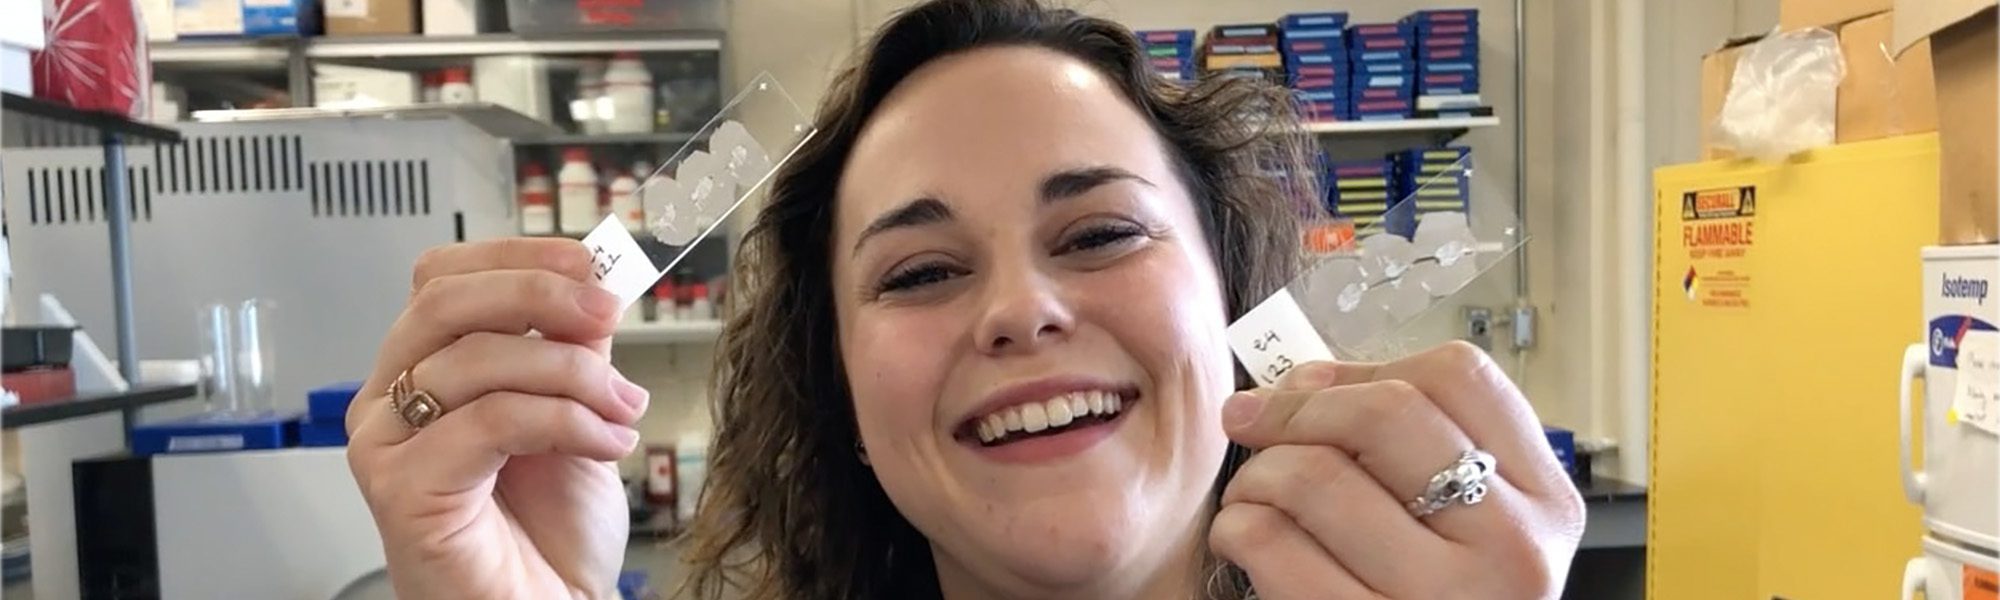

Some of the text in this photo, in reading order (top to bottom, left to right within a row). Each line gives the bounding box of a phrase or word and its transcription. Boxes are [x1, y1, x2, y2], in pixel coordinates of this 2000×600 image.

[1683, 222, 1753, 247] FLAMMABLE
[594, 253, 622, 281] 122
[1941, 272, 1989, 306] Isotemp
[1260, 354, 1294, 384] 123
